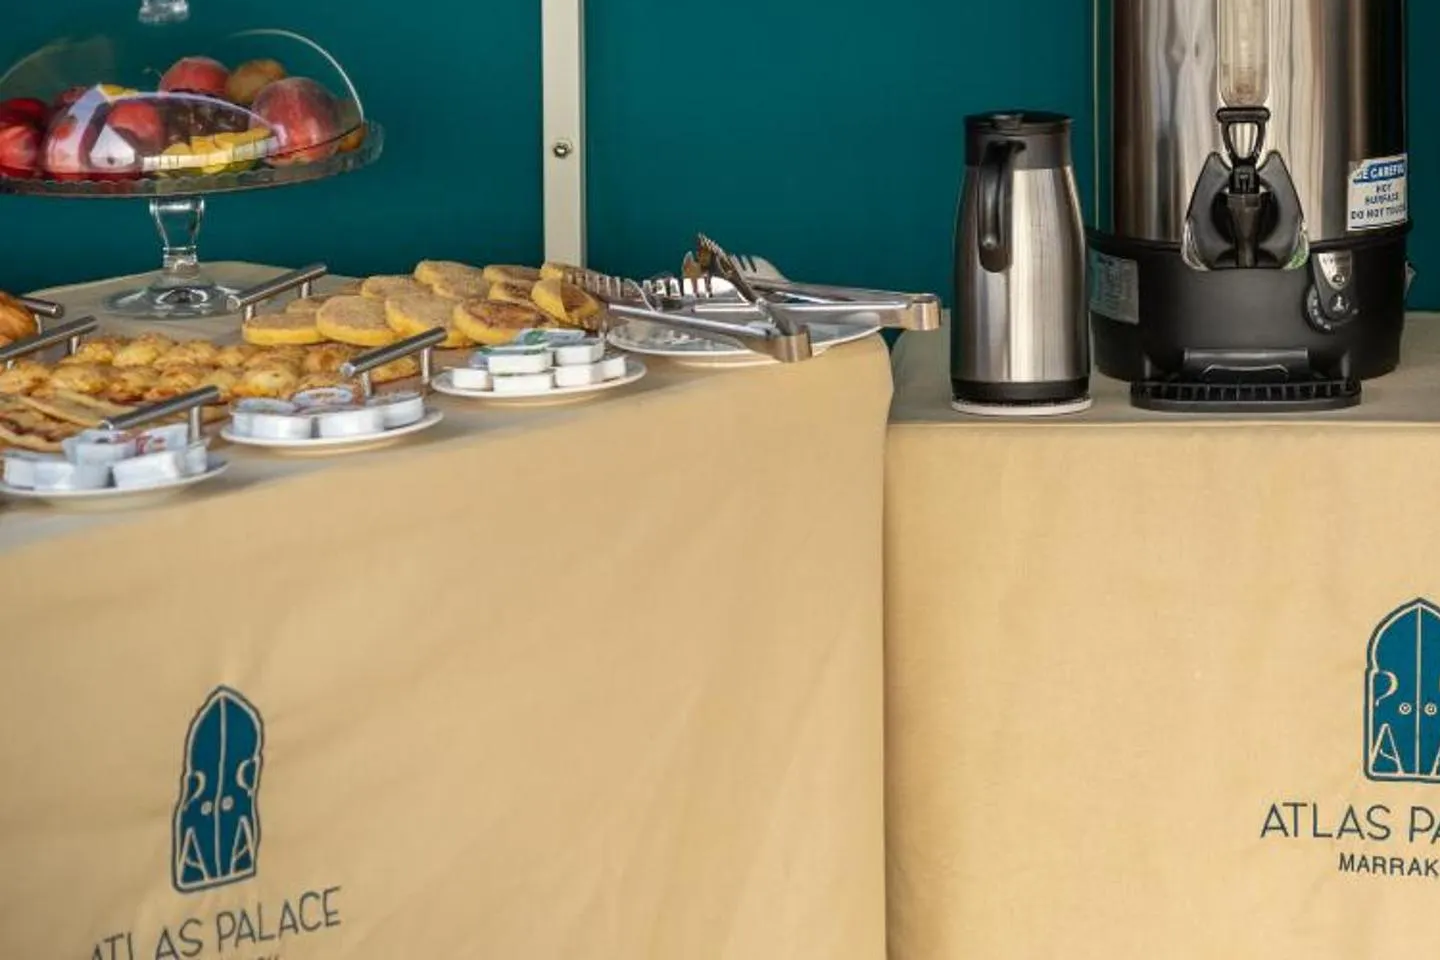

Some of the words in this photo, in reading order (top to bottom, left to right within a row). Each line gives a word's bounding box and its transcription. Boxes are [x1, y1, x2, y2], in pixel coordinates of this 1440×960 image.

[1351, 210, 1364, 220] DO
[1366, 208, 1384, 219] NOT
[1260, 802, 1392, 841] ATLAS
[214, 887, 342, 953] PALACE
